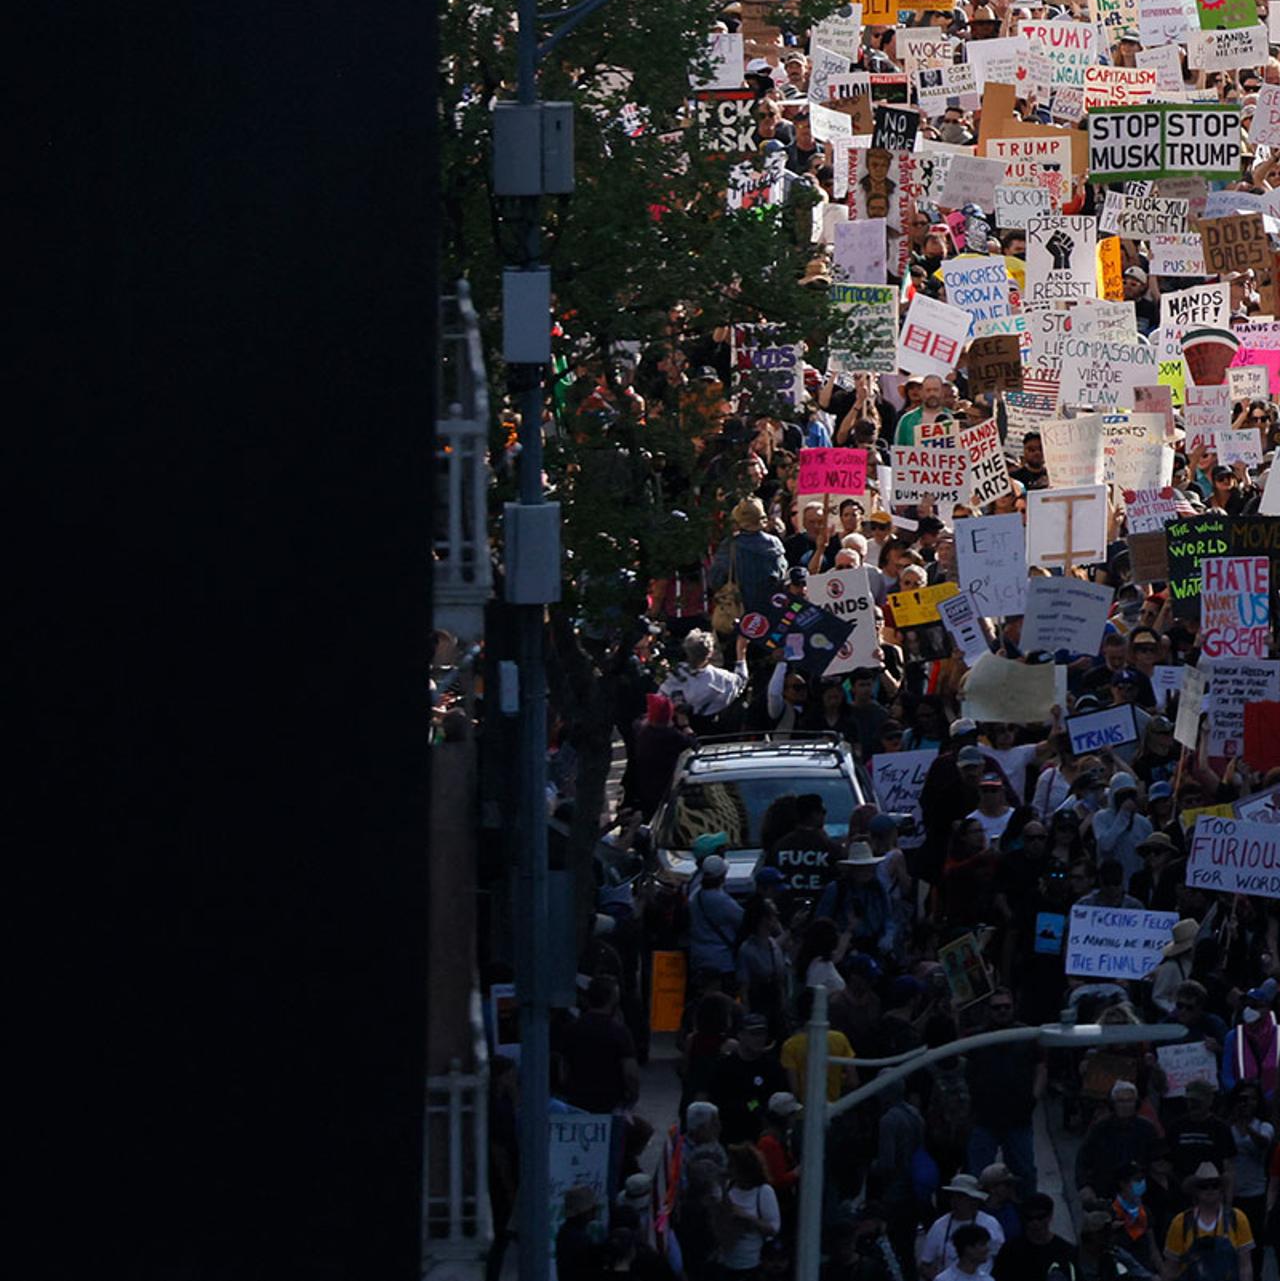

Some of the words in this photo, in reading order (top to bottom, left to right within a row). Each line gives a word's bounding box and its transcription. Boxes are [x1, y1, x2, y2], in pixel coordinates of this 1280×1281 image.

[908, 41, 951, 58] WOKE
[884, 112, 907, 132] NO
[1092, 113, 1159, 140] STOP
[1167, 113, 1239, 137] STOP
[876, 130, 915, 150] MORE
[996, 141, 1060, 156] TRUMP
[1091, 146, 1159, 171] MUSK
[1166, 143, 1240, 167] TRUMP
[1027, 216, 1069, 243] RISE
[1073, 218, 1094, 238] UP
[1046, 271, 1072, 282] AND
[1033, 282, 1090, 300] RESIST
[1064, 340, 1154, 360] COMPASSION
[1078, 368, 1122, 384] VIRTUE
[1078, 389, 1119, 405] FLAW
[896, 451, 968, 469] TARIFFS
[911, 469, 964, 487] TAXES
[1170, 539, 1228, 557] WORLD
[1073, 725, 1124, 749] TRANS
[1200, 819, 1236, 834] TOO
[777, 849, 830, 868] FUCK
[1192, 868, 1224, 886] FOR
